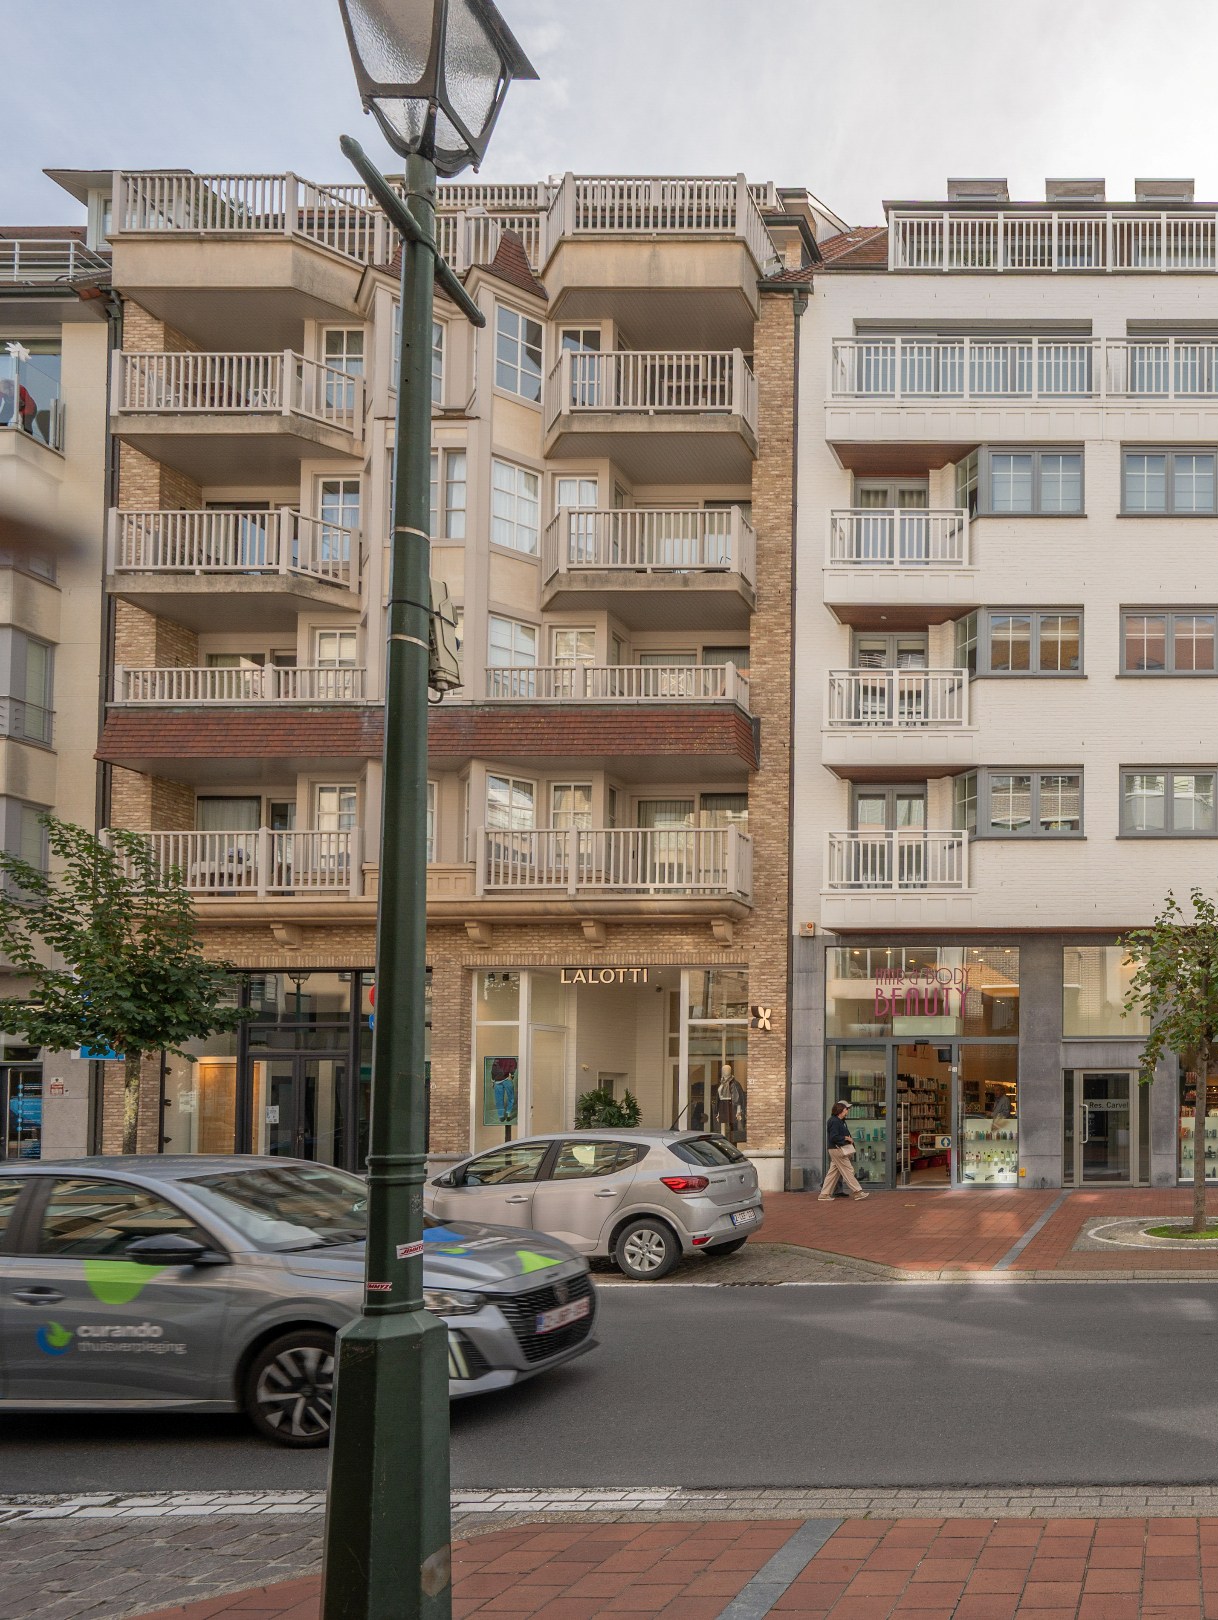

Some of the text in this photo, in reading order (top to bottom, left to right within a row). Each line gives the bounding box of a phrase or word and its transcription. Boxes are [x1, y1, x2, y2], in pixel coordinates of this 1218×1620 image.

[560, 968, 648, 983] LALOTTI
[875, 968, 905, 985] HAIR
[926, 967, 972, 985] BODY
[874, 987, 972, 1017] BEAUTY
[1089, 1101, 1129, 1109] Res. Carvel
[76, 1322, 164, 1338] curando
